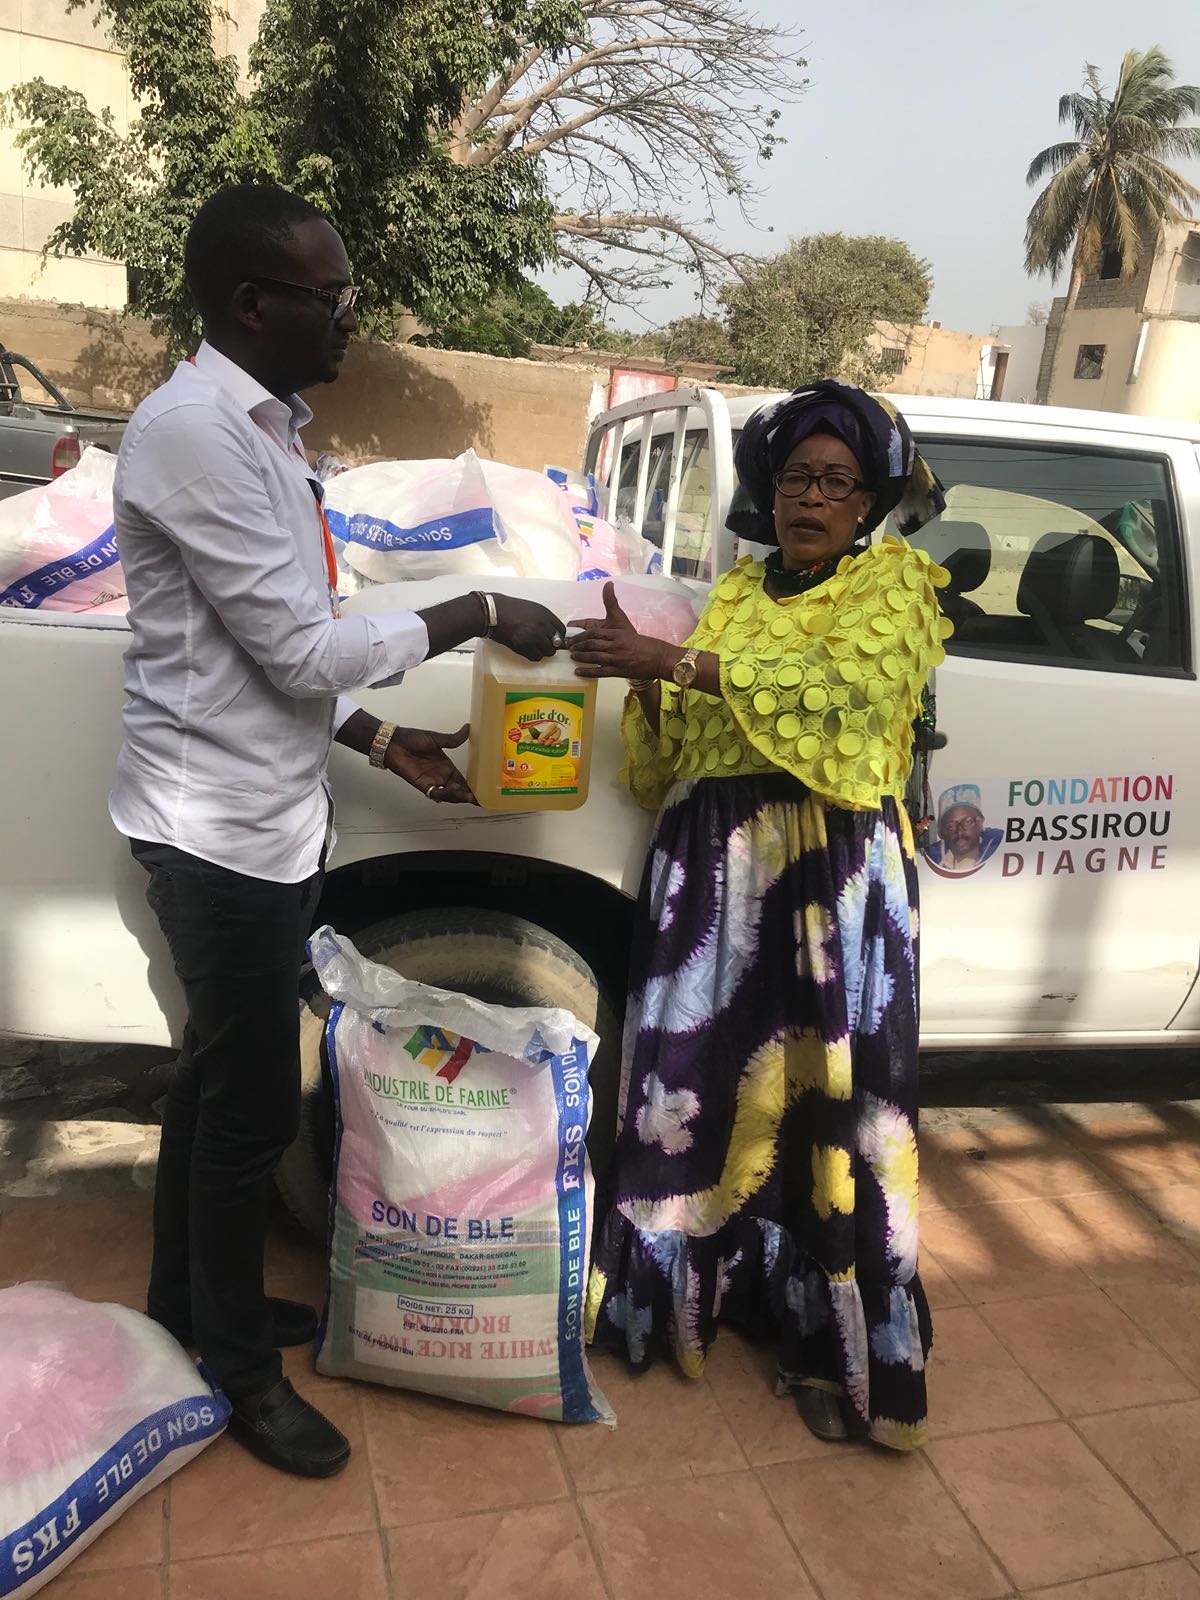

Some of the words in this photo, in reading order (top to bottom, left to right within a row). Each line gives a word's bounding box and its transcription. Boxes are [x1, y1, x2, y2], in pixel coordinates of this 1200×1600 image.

[40, 566, 77, 586] BLE
[75, 554, 103, 572] DE
[518, 709, 545, 724] Huile
[1008, 774, 1173, 807] FONDATION
[1005, 811, 1171, 843] BASSIROU
[1002, 845, 1168, 877] DIAGNE
[364, 1067, 430, 1100] INDUSTRIE
[435, 1085, 454, 1103] DE
[563, 1066, 580, 1106] SON
[420, 1124, 464, 1136] l'expression
[562, 1124, 584, 1191] FKS
[372, 1200, 417, 1233] SON
[426, 1216, 458, 1239] DE
[468, 1216, 514, 1239] BLE
[568, 1207, 580, 1248] BLE
[568, 1255, 580, 1288] DE
[400, 1299, 423, 1311] POIDS
[425, 1305, 443, 1314] NET:
[445, 1306, 456, 1315] 25
[459, 1307, 470, 1315] KG
[565, 1294, 579, 1341] SON
[417, 1339, 473, 1360] RICE
[480, 1337, 554, 1360] WHITE
[167, 1405, 215, 1441] SON
[133, 1429, 163, 1465] DE
[96, 1452, 134, 1502] BLE
[12, 1498, 81, 1575] FKS
